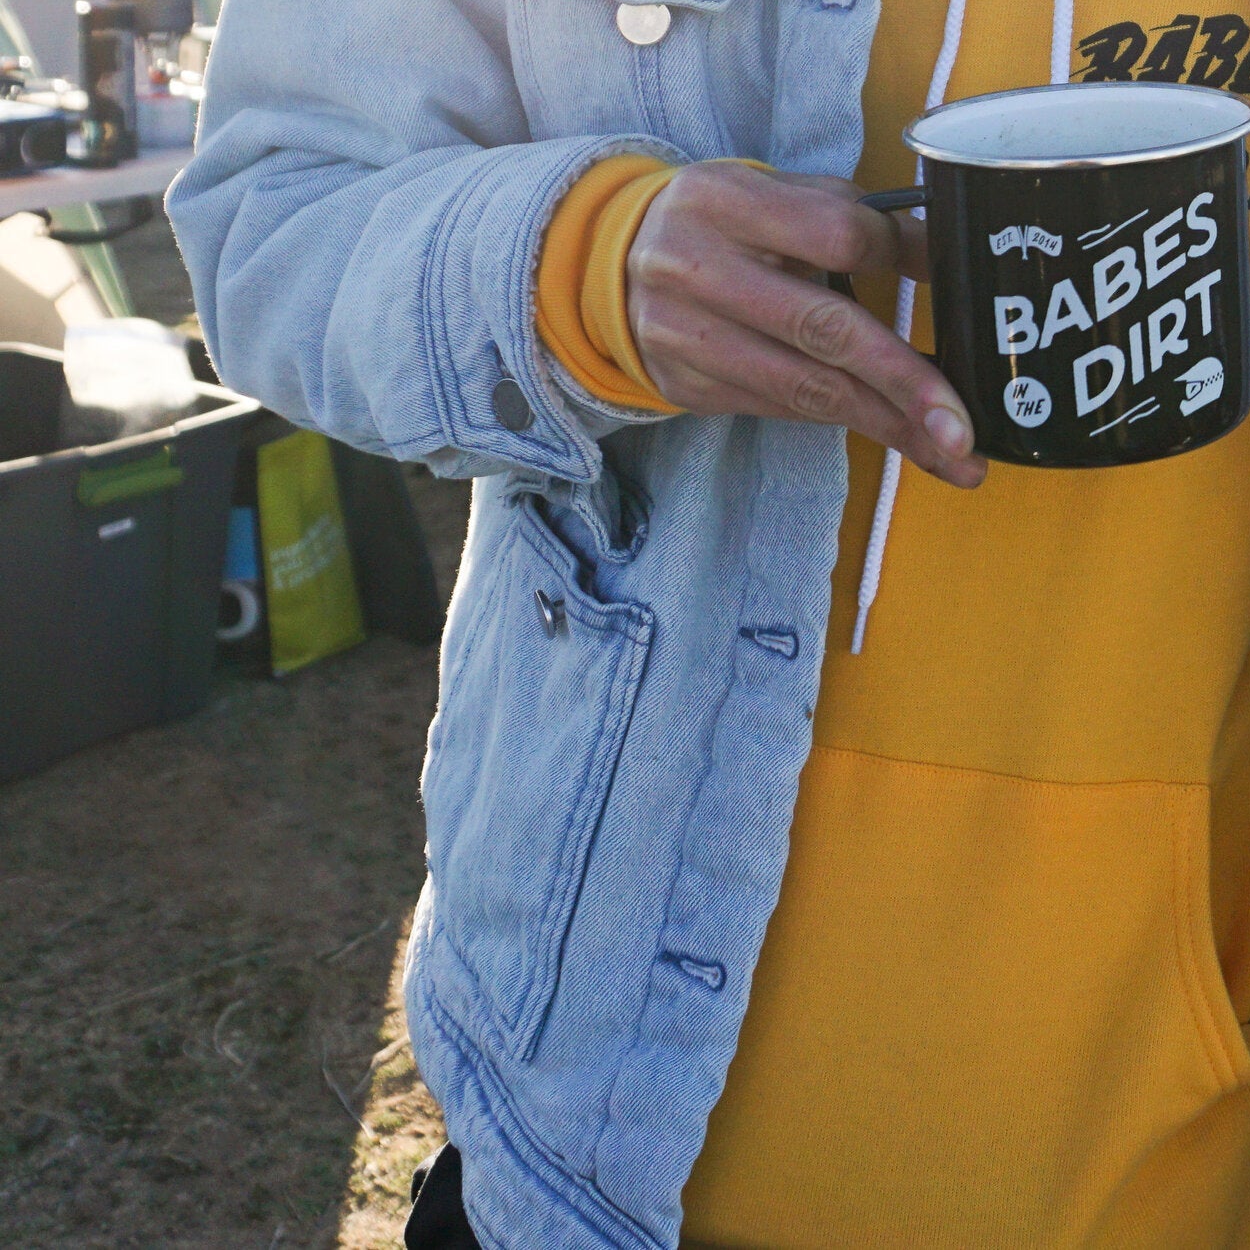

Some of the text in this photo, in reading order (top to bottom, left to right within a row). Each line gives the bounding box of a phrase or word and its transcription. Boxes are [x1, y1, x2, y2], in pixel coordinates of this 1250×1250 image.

[996, 231, 1058, 251] EST. 2014
[993, 191, 1218, 355] BABES
[1072, 268, 1222, 418] DIRT
[1012, 382, 1029, 399] IN
[1016, 398, 1046, 417] THE
